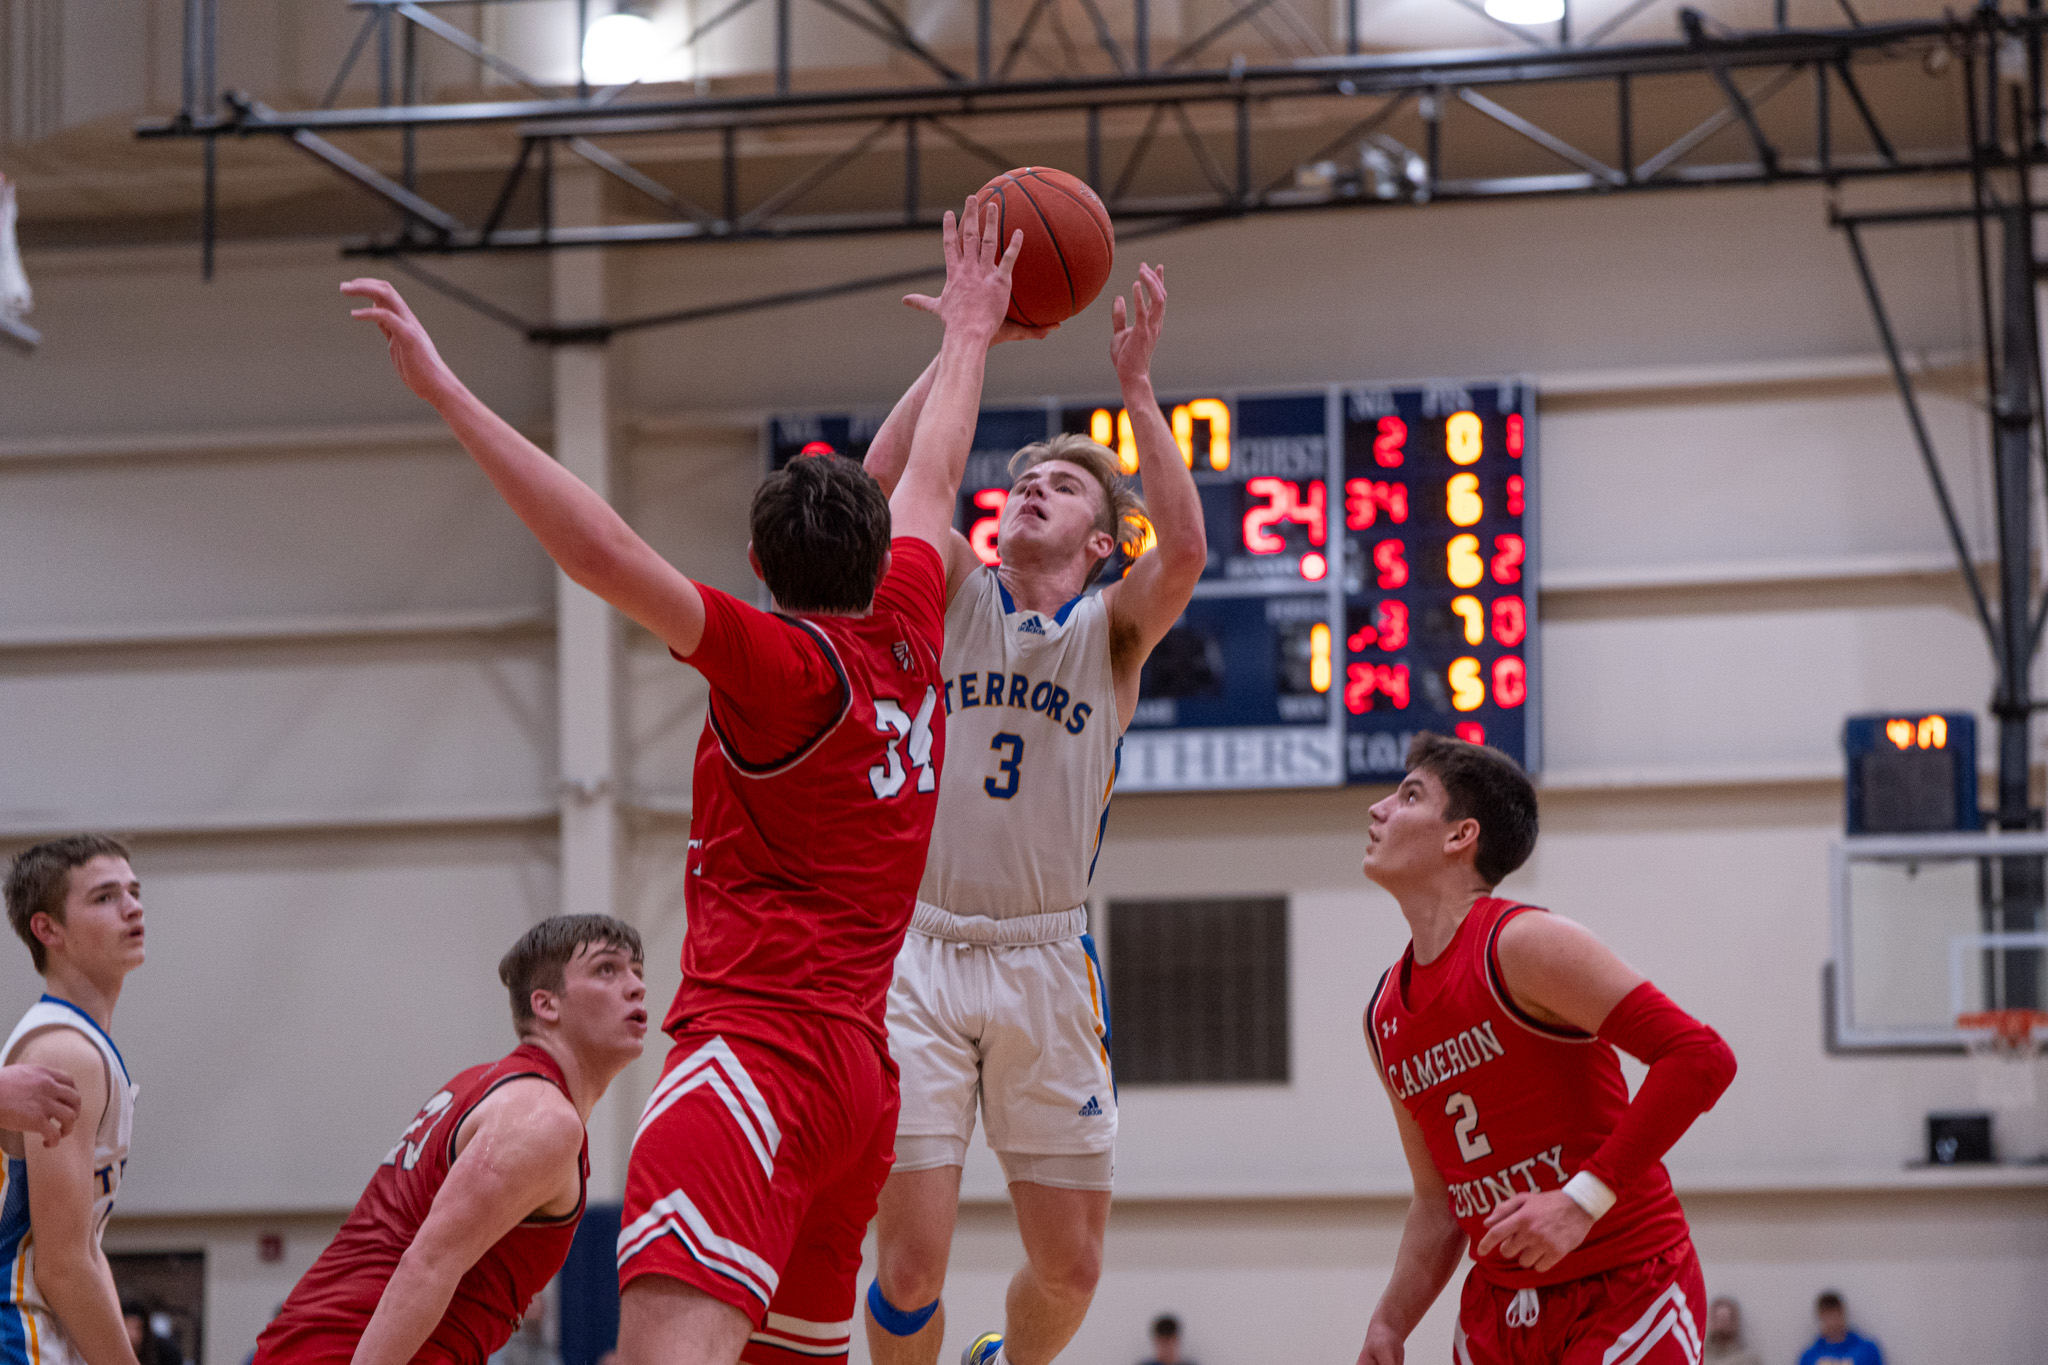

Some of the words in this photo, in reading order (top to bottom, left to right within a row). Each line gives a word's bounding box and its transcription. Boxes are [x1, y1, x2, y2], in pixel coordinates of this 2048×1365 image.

[1373, 415, 1408, 468] 2
[1445, 411, 1483, 466] 0
[1242, 476, 1328, 555] 24
[1345, 477, 1408, 531] 34
[1446, 472, 1484, 527] 6
[1373, 538, 1409, 590] 5
[1446, 533, 1485, 588] 6
[1490, 533, 1526, 585] 2
[1451, 594, 1485, 646] 7
[1491, 594, 1527, 647] 0
[1310, 622, 1332, 693] 1
[1448, 656, 1486, 712] 5
[945, 672, 1093, 735] TERRORS
[1344, 661, 1410, 715] 24
[868, 682, 937, 799] 34
[983, 731, 1025, 800] 3
[1388, 1019, 1506, 1101] CAMERON
[1444, 1091, 1493, 1164] 2
